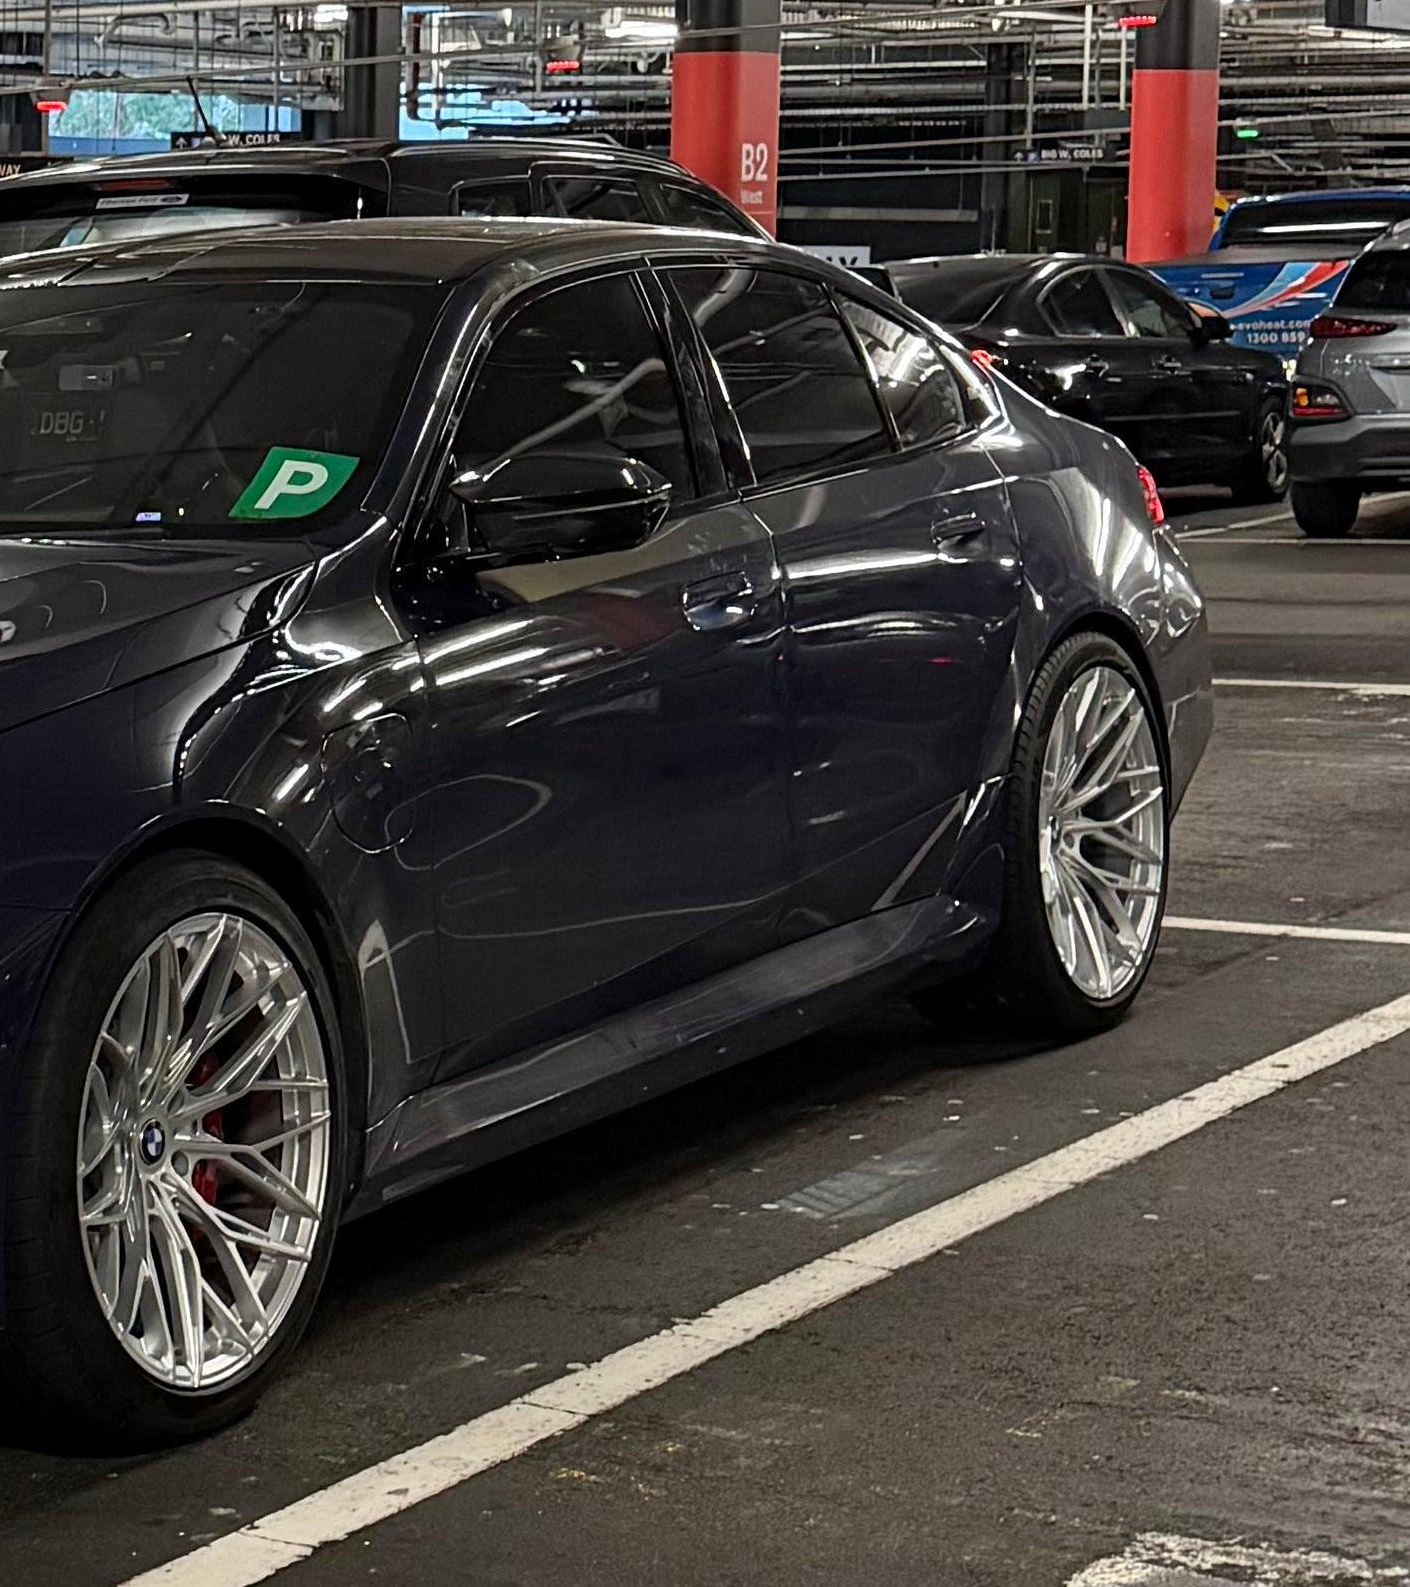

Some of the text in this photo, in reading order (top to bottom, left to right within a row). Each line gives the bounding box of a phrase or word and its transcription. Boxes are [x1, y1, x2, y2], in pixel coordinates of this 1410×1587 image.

[741, 143, 768, 182] B2
[1247, 331, 1278, 344] 1300
[254, 459, 329, 510] P
